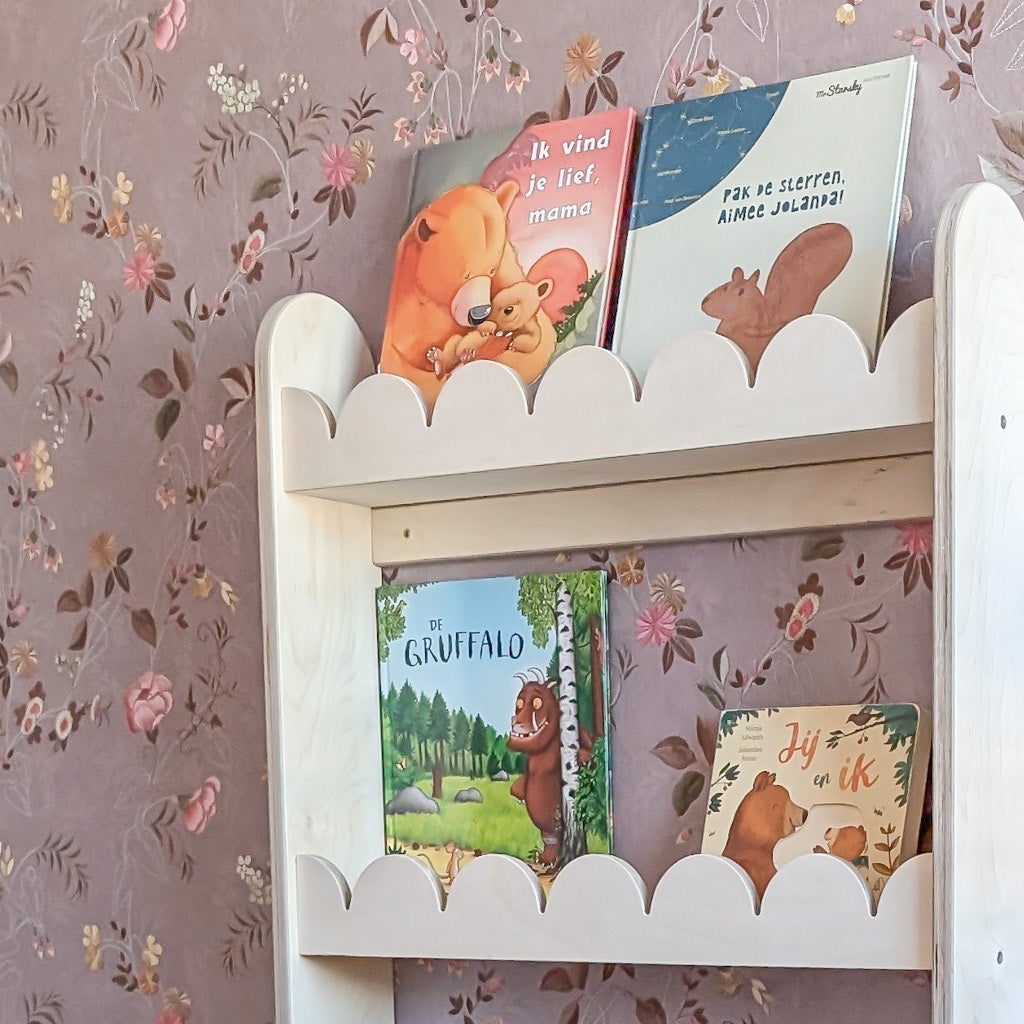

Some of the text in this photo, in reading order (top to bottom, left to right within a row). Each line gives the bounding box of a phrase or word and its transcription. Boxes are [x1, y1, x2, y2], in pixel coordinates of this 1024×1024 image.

[530, 129, 610, 161] Ik vind
[524, 164, 600, 198] je lief,
[723, 186, 751, 203] Pak
[779, 170, 845, 193] sterren,
[528, 201, 592, 225] mama
[429, 618, 443, 631] DE
[404, 630, 525, 667] GRUFFALO
[778, 722, 821, 770] Jij
[813, 753, 879, 793] en ik
